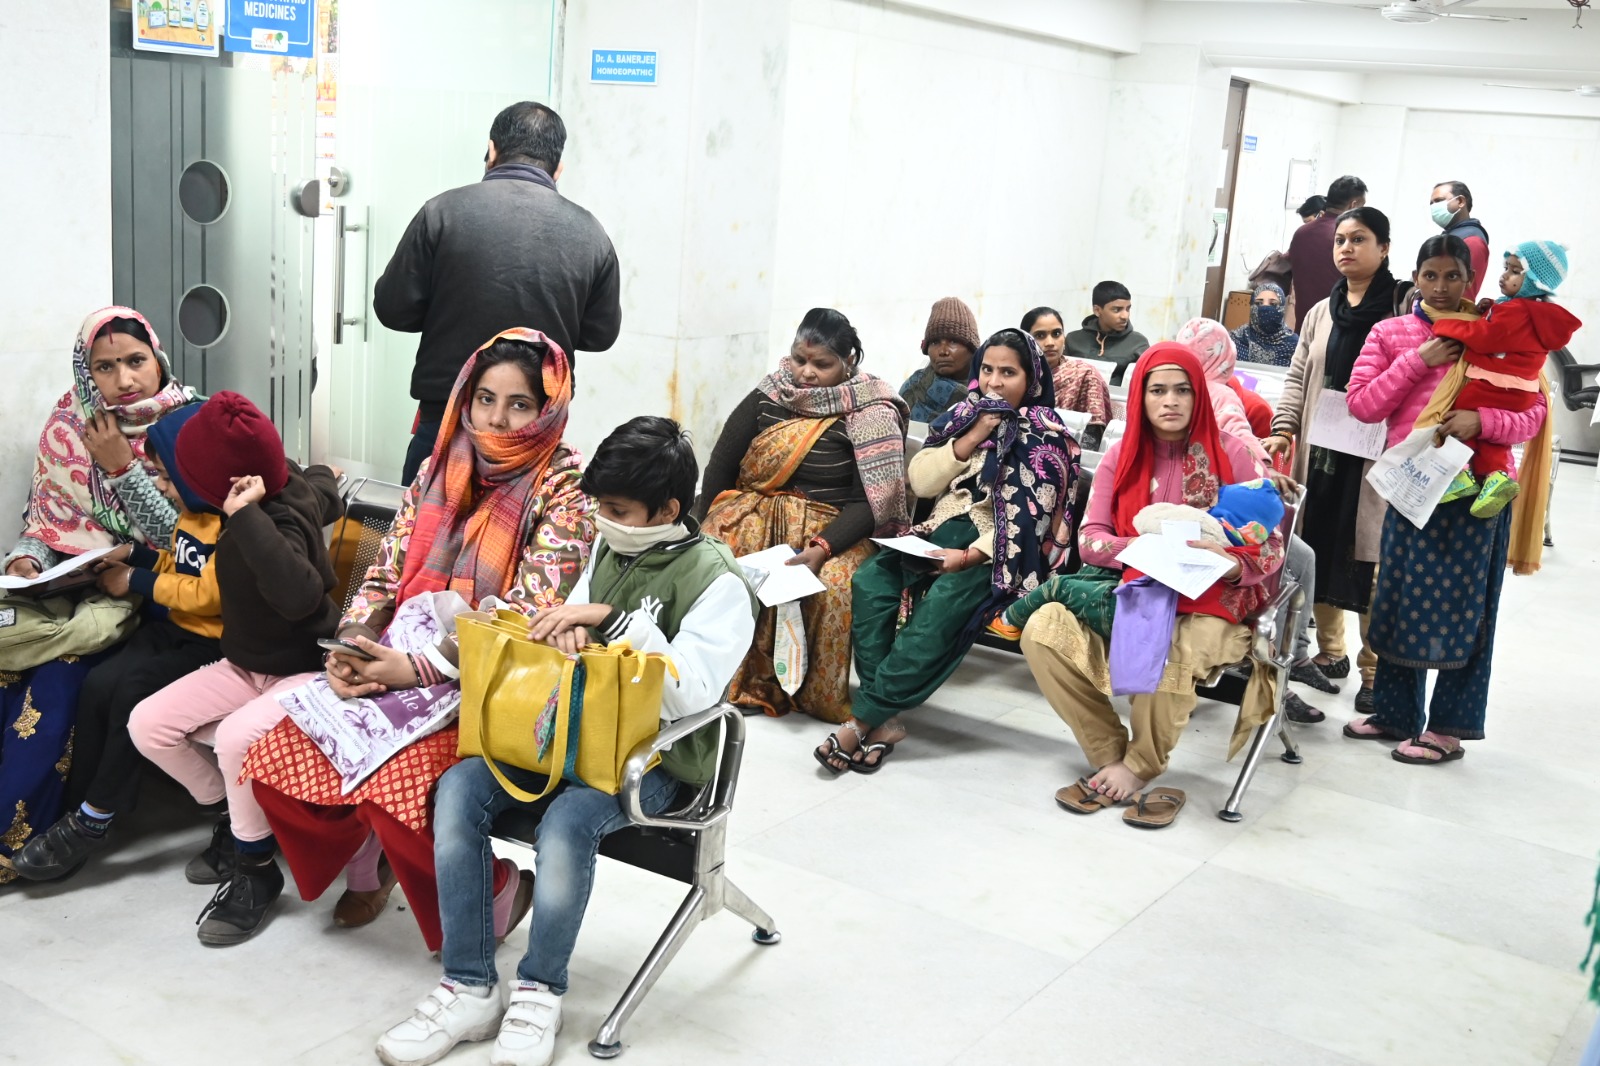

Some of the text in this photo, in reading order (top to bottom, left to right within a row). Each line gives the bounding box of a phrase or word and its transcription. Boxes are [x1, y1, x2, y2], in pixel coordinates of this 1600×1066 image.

[244, 1, 297, 21] MEDICINES
[595, 54, 656, 65] Dr. A. BANERJEE
[597, 67, 653, 77] HOMOEOPATHIC
